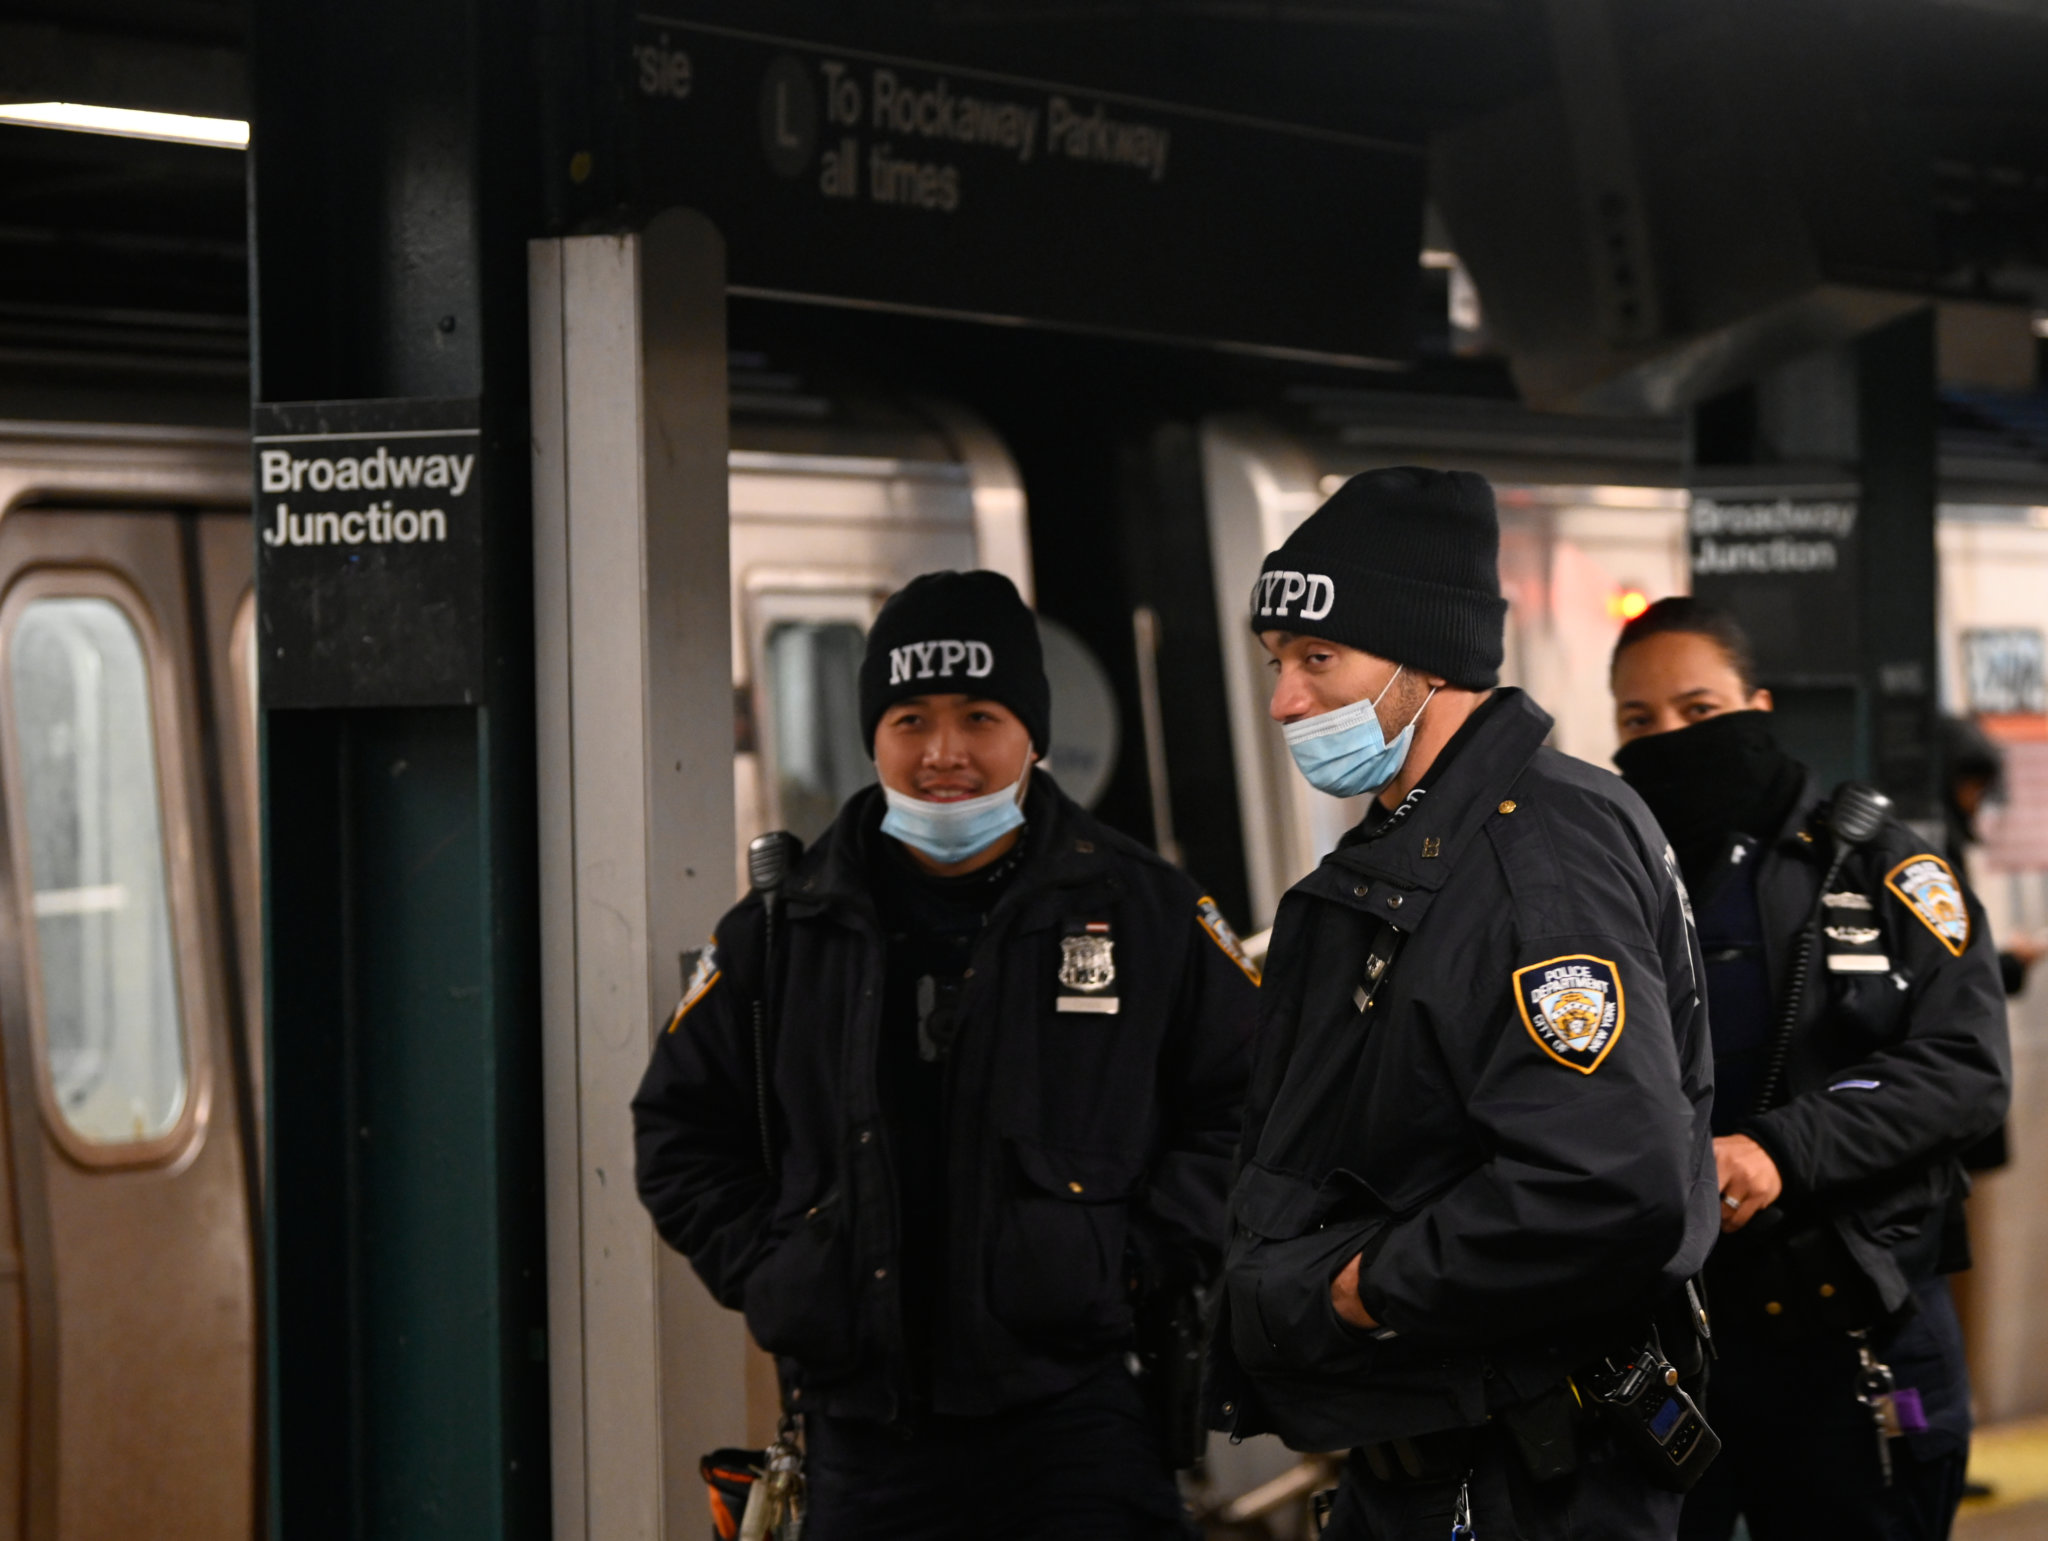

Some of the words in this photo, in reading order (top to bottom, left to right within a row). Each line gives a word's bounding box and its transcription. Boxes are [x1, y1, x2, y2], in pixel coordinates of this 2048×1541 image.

[775, 79, 799, 147] L
[821, 60, 862, 125] To
[872, 67, 1041, 164] Rockaway
[1047, 95, 1171, 182] Parkway
[821, 137, 858, 198] all
[870, 142, 960, 213] times
[261, 446, 474, 496] Broadway
[263, 501, 447, 547] Junction
[1693, 497, 1858, 539] Broadway
[1694, 537, 1838, 574] Junction
[889, 640, 993, 685] NYPD
[1531, 977, 1609, 1003] DEPARTMENT
[1544, 966, 1592, 982] POLICE
